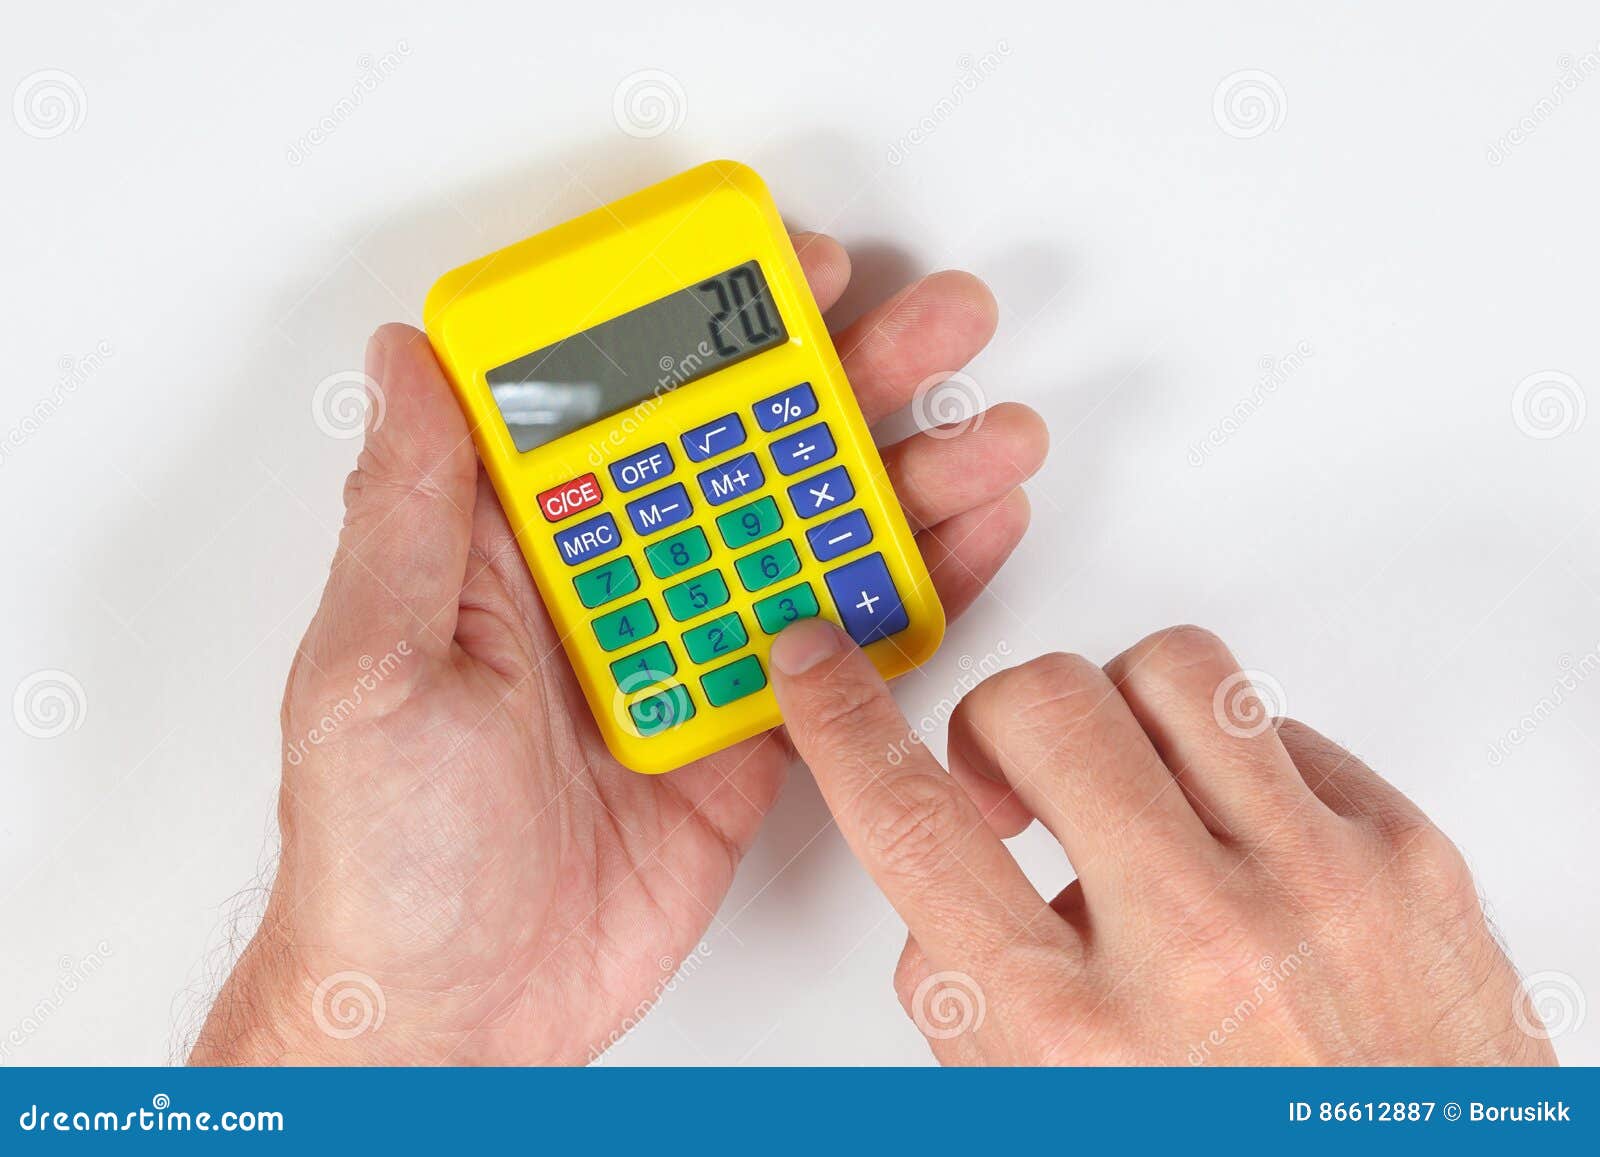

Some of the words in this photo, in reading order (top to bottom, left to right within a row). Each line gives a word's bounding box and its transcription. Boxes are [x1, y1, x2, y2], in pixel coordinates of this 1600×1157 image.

[771, 397, 801, 422] %
[621, 454, 662, 484] OFF
[711, 470, 750, 498] M+
[546, 482, 597, 515] C/CE
[742, 513, 761, 537] 9
[563, 525, 612, 558] MRC
[670, 543, 690, 566] 8
[760, 555, 780, 579] 6
[596, 571, 613, 596] 7
[689, 584, 708, 609] 5
[778, 598, 799, 622] 3
[618, 615, 634, 638] 4
[707, 628, 729, 653] 2
[637, 658, 654, 680] 1
